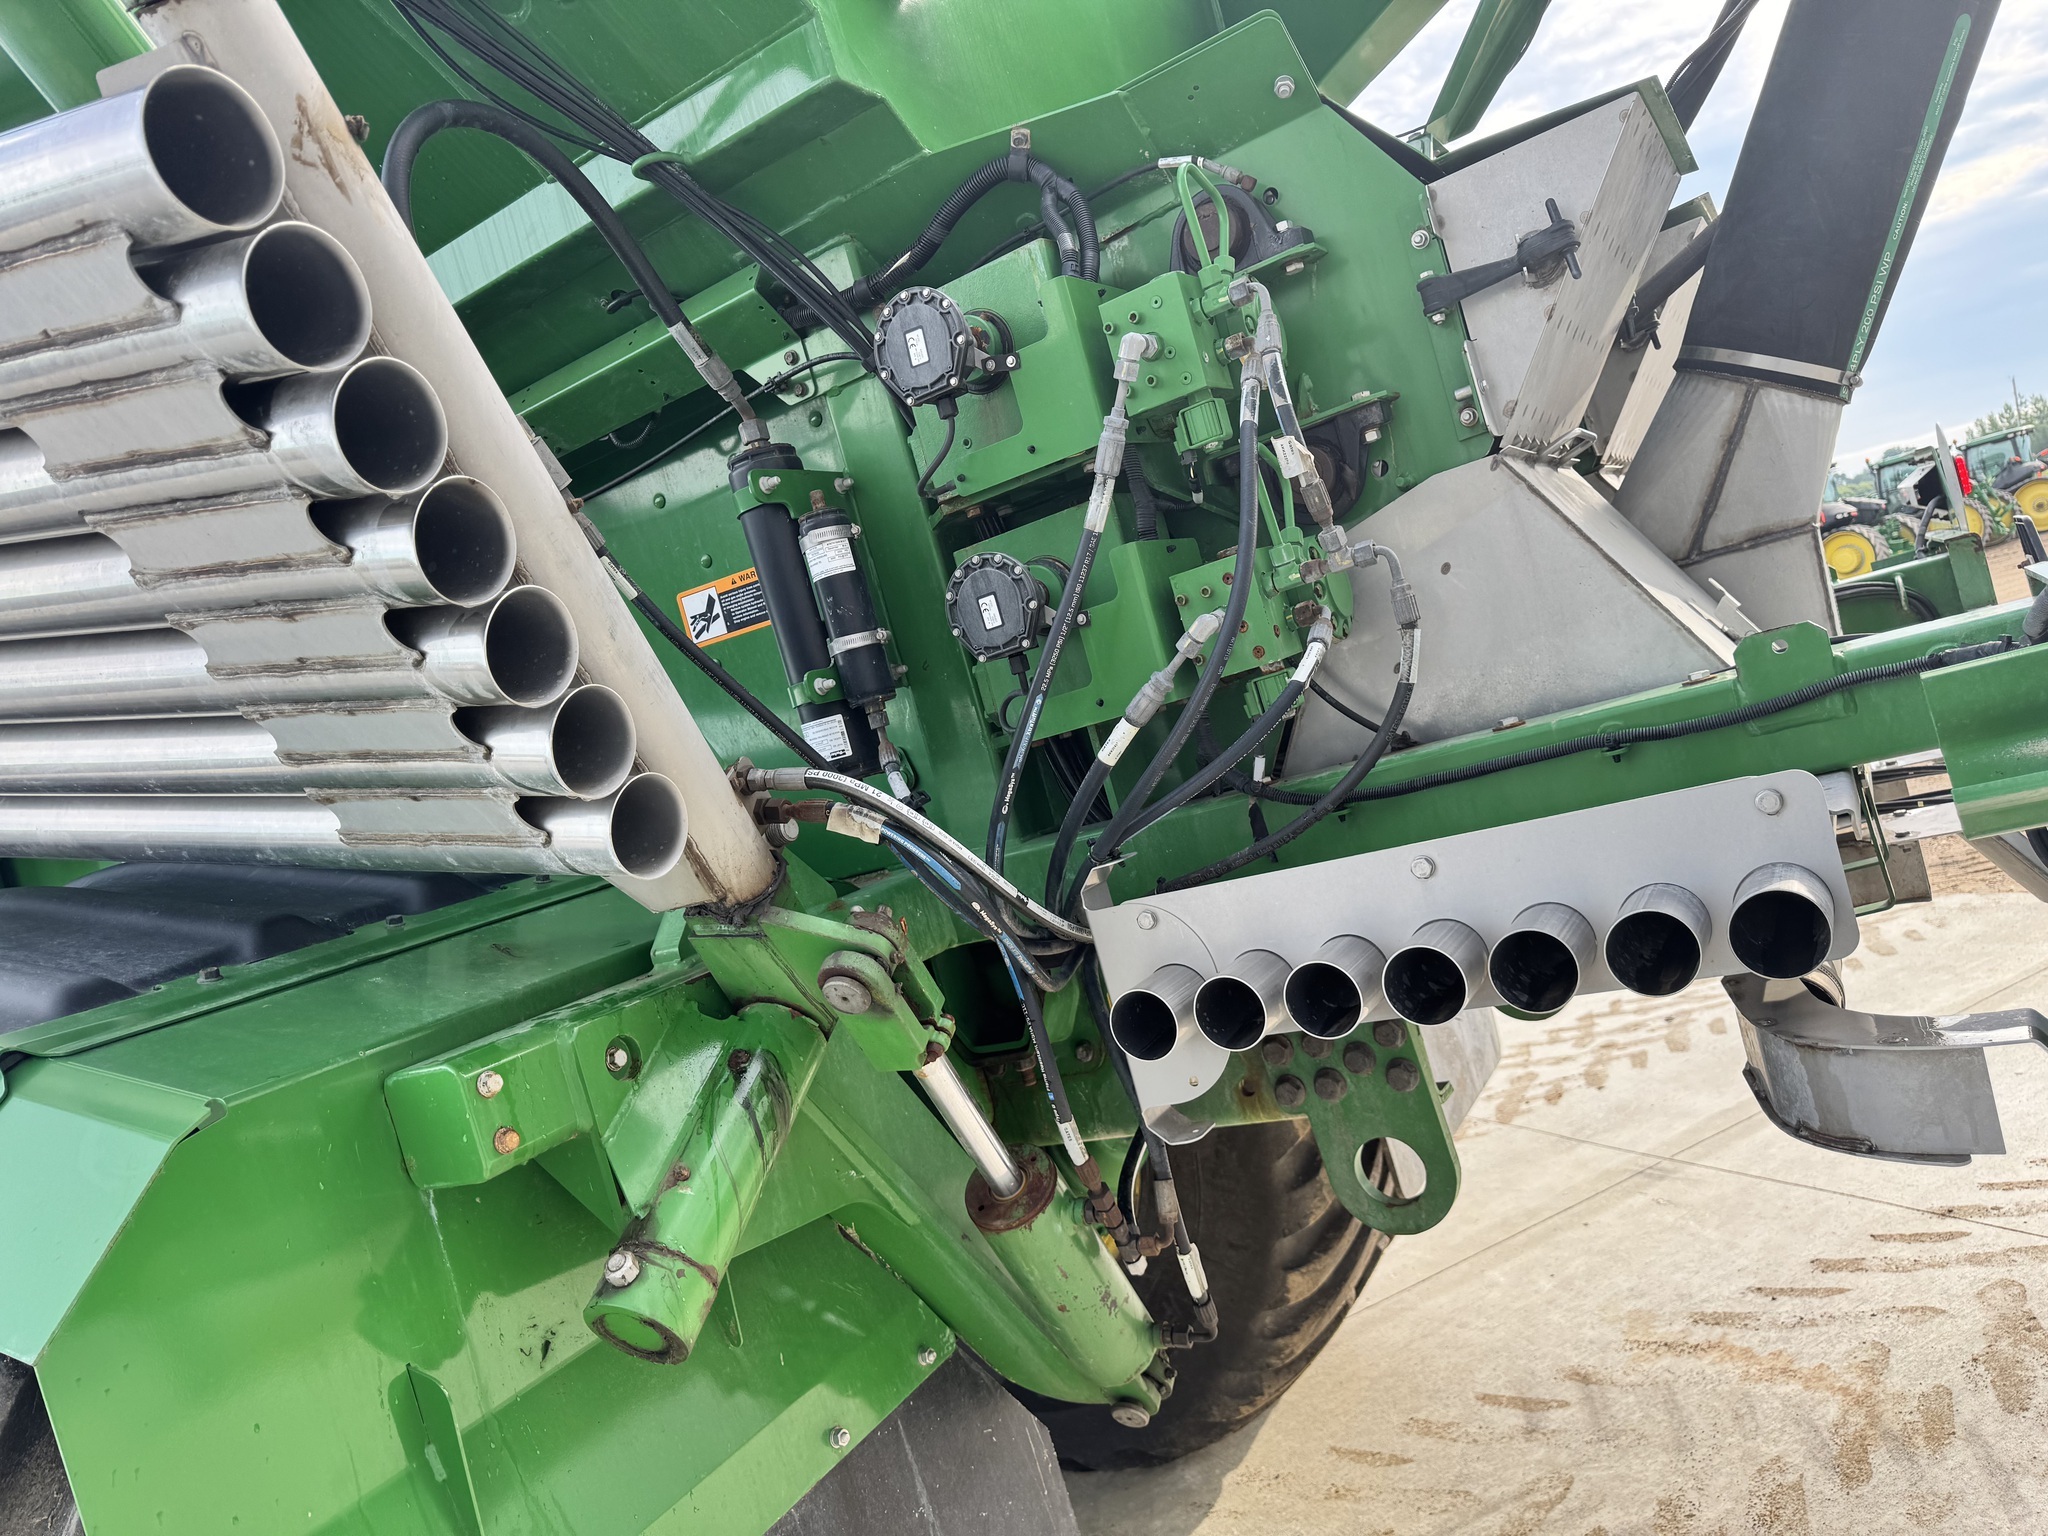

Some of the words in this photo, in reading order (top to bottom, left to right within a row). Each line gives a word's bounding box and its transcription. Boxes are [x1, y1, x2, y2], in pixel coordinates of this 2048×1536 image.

[1892, 200, 1909, 240] CAUTION:
[1848, 336, 1866, 372] 4PLY
[1860, 307, 1875, 334] 200
[1869, 280, 1884, 305] PSI
[1878, 251, 1893, 278] WP
[1083, 551, 1093, 565] R17
[1077, 564, 1090, 584] 11237
[1075, 583, 1083, 594] ISO
[1069, 593, 1080, 609] mm)
[1064, 608, 1075, 624] (12.5
[1055, 635, 1065, 649] PSI)
[1049, 648, 1061, 666] (3250
[1044, 665, 1054, 679] MPa
[1040, 678, 1050, 692] 22.5
[822, 771, 847, 783] (3000
[849, 779, 870, 792] MPa
[871, 788, 883, 798] 21
[1277, 831, 1296, 846] USA
[1063, 1127, 1073, 1142] GATES
